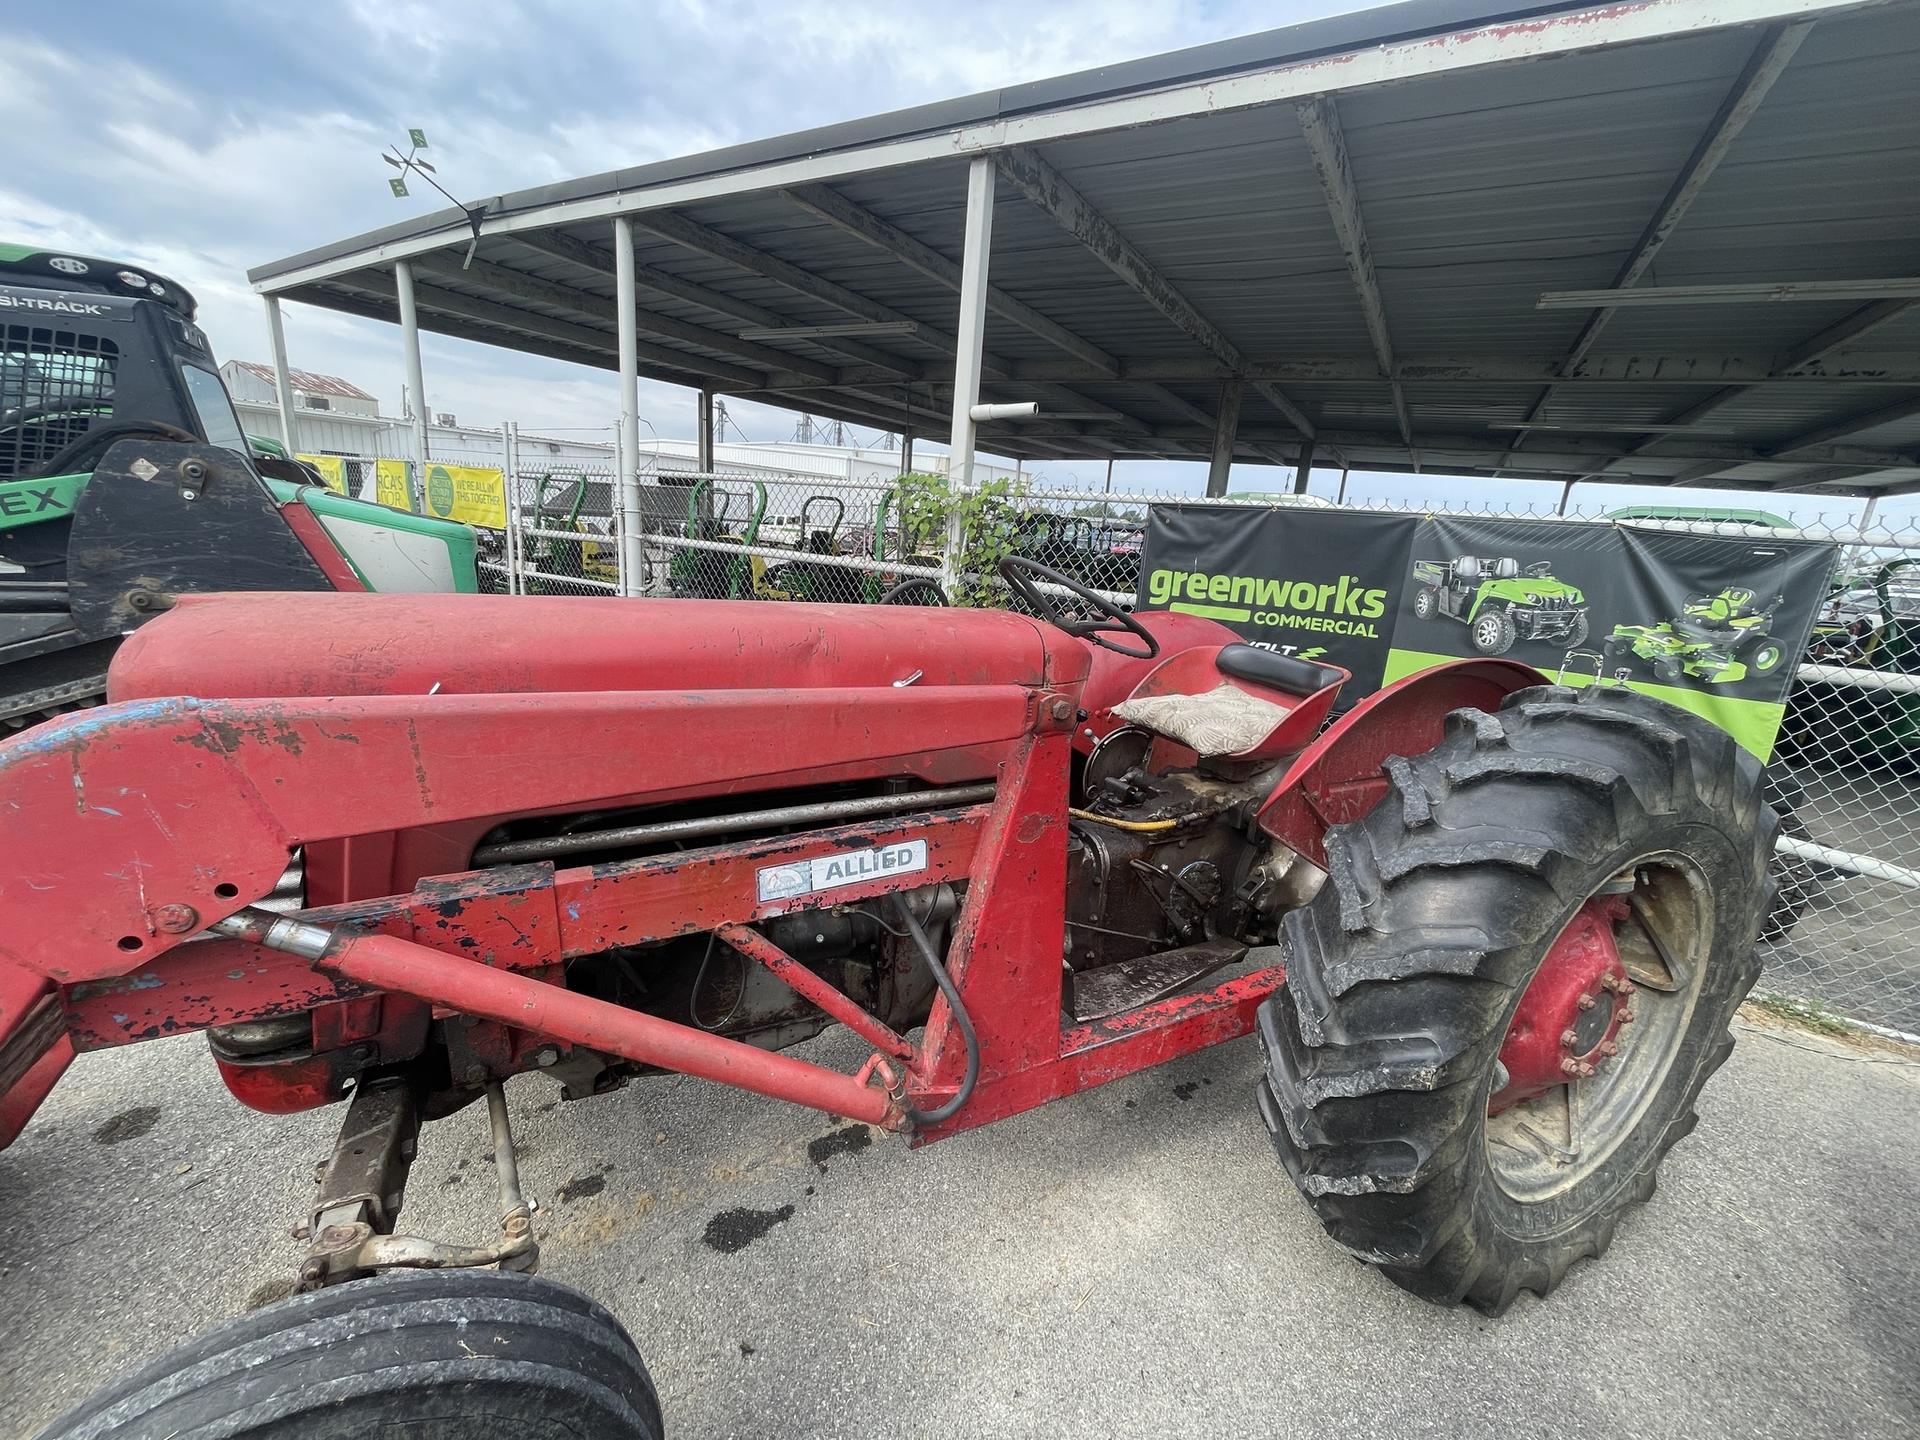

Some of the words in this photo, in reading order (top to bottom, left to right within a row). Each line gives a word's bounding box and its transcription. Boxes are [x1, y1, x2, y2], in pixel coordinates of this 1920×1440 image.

[456, 480, 475, 491] WE'RE
[476, 481, 487, 493] ALL
[487, 482, 495, 494] IN
[456, 490, 469, 502] THIS
[1253, 611, 1379, 637] COMMERCIAL
[825, 848, 913, 881] ALLIED
